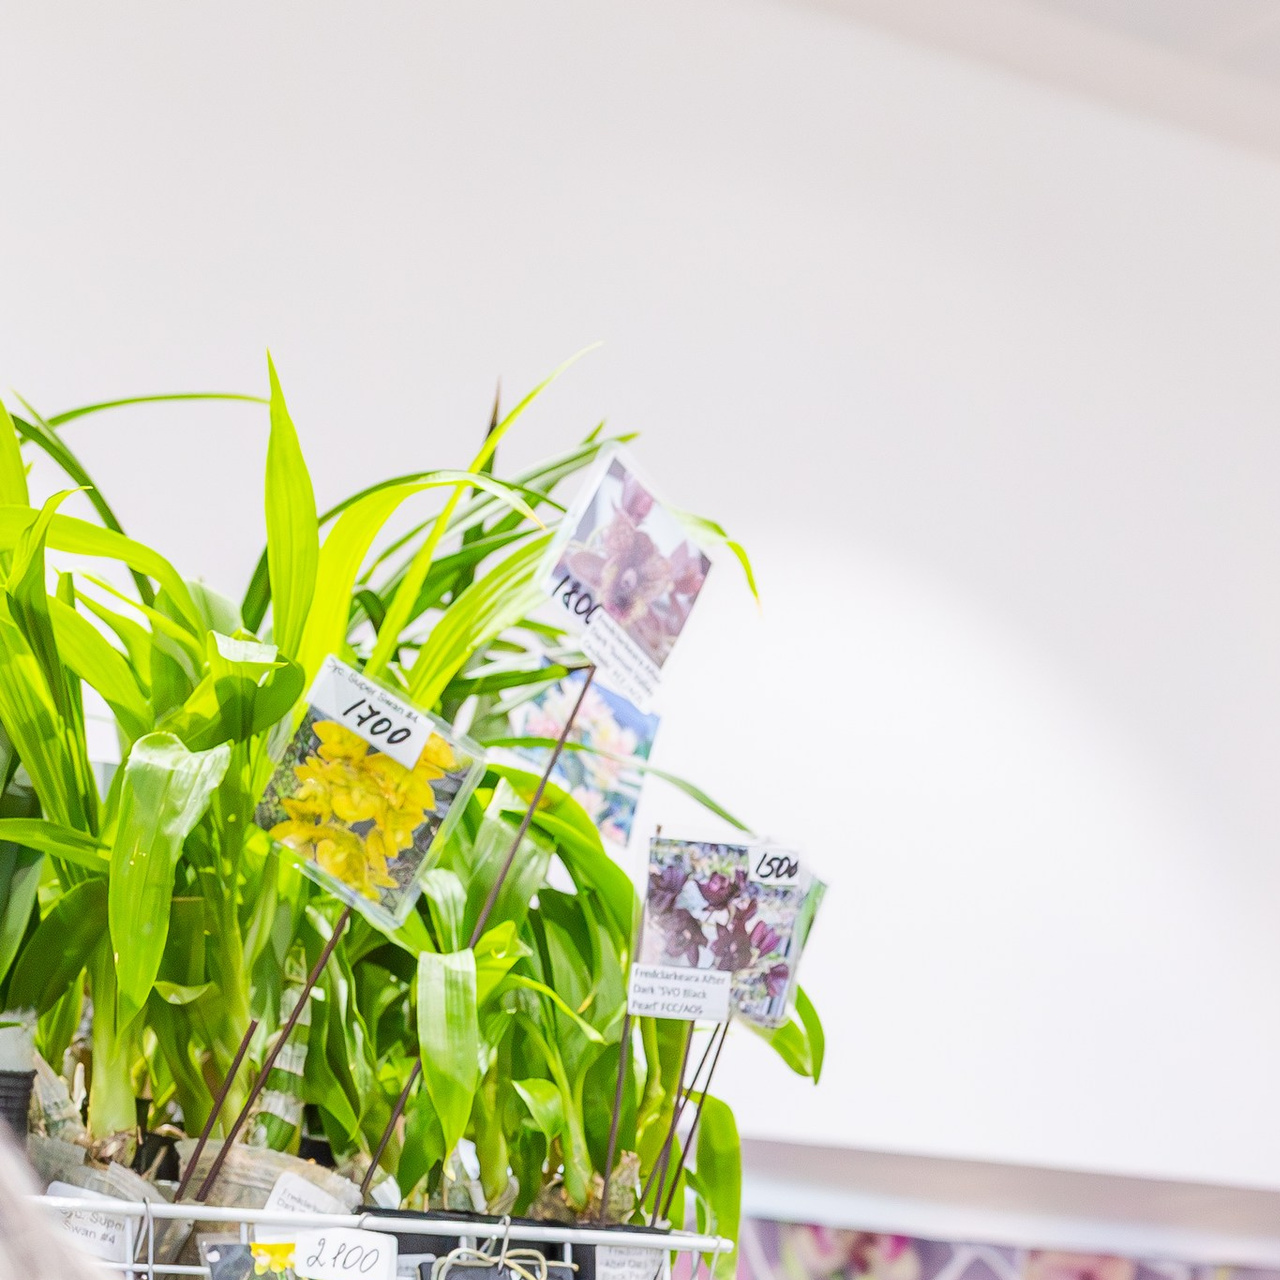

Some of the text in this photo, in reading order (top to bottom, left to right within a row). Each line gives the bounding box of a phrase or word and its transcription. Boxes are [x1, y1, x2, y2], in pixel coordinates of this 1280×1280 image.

[343, 698, 412, 745] 1700
[63, 1220, 97, 1239] Swan
[307, 1238, 380, 1273] 2100
